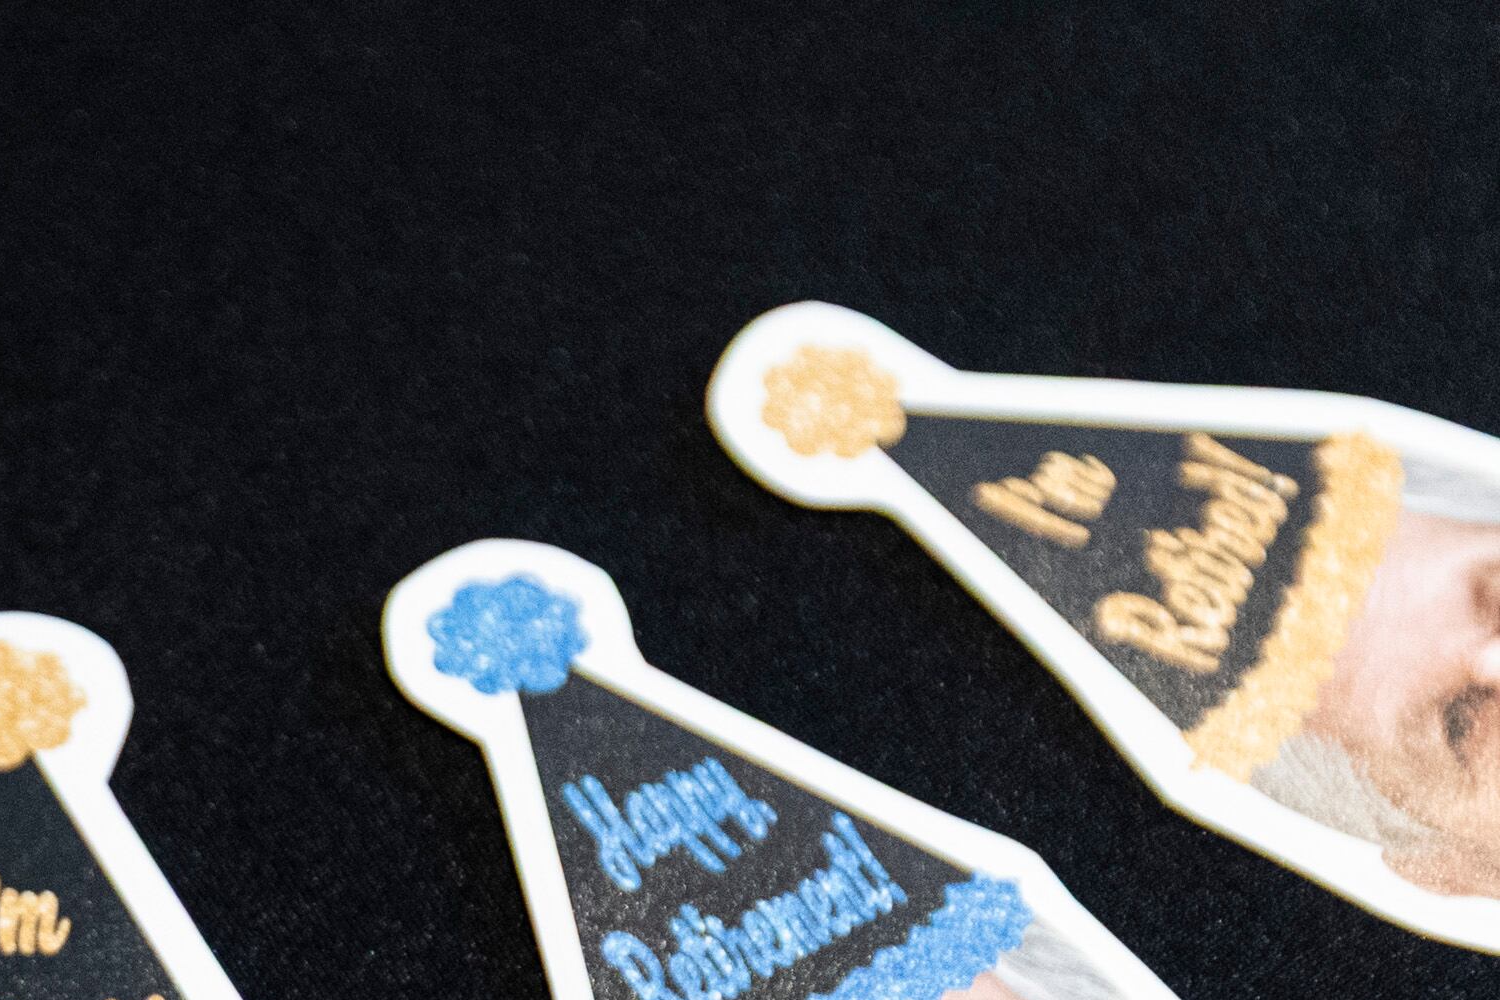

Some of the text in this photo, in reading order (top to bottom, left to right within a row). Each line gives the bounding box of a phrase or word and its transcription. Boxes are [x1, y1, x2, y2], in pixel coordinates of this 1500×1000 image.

[973, 450, 1117, 549] I'm
[1095, 432, 1299, 673] Retired!
[562, 756, 778, 892] Happy
